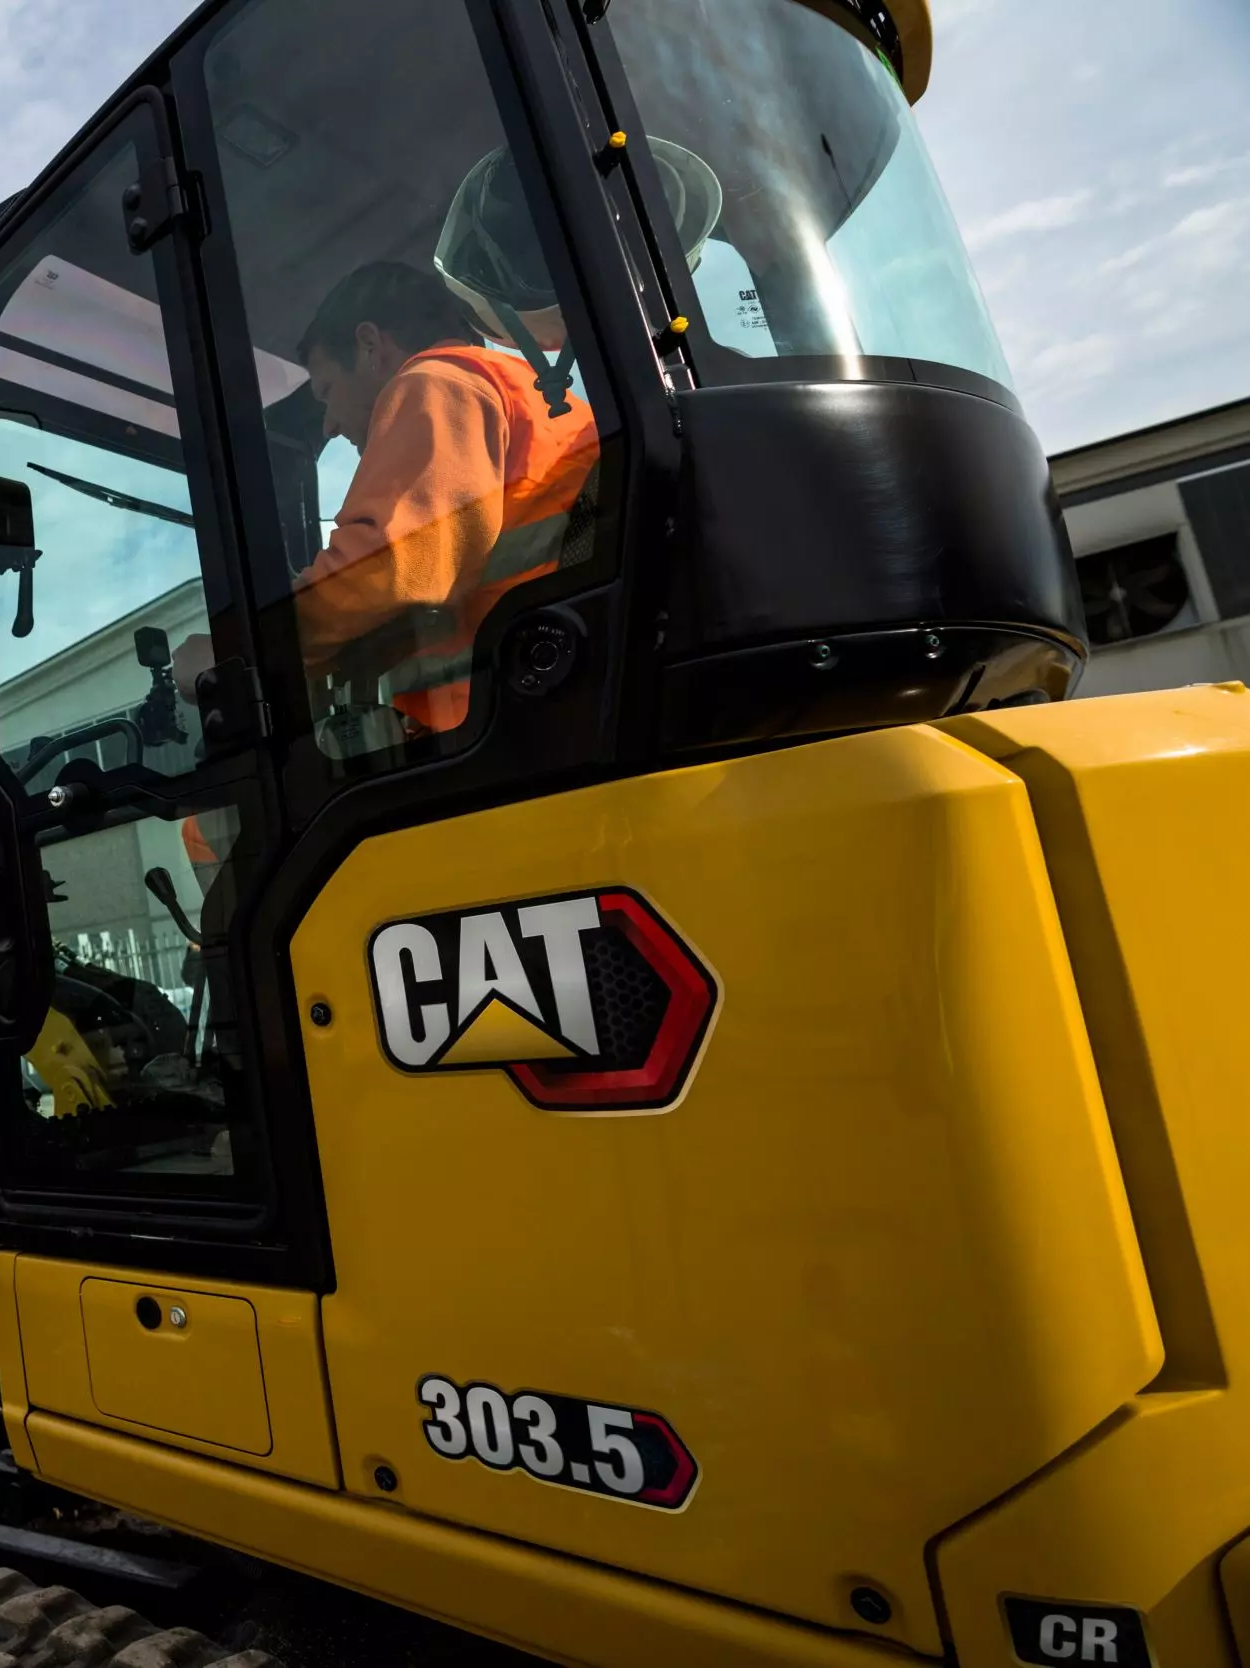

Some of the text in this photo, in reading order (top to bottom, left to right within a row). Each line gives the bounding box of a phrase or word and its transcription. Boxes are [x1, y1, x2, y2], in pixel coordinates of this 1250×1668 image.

[372, 896, 601, 1066] CAT
[421, 1378, 645, 1495] 303.5
[1039, 1614, 1118, 1663] CR
